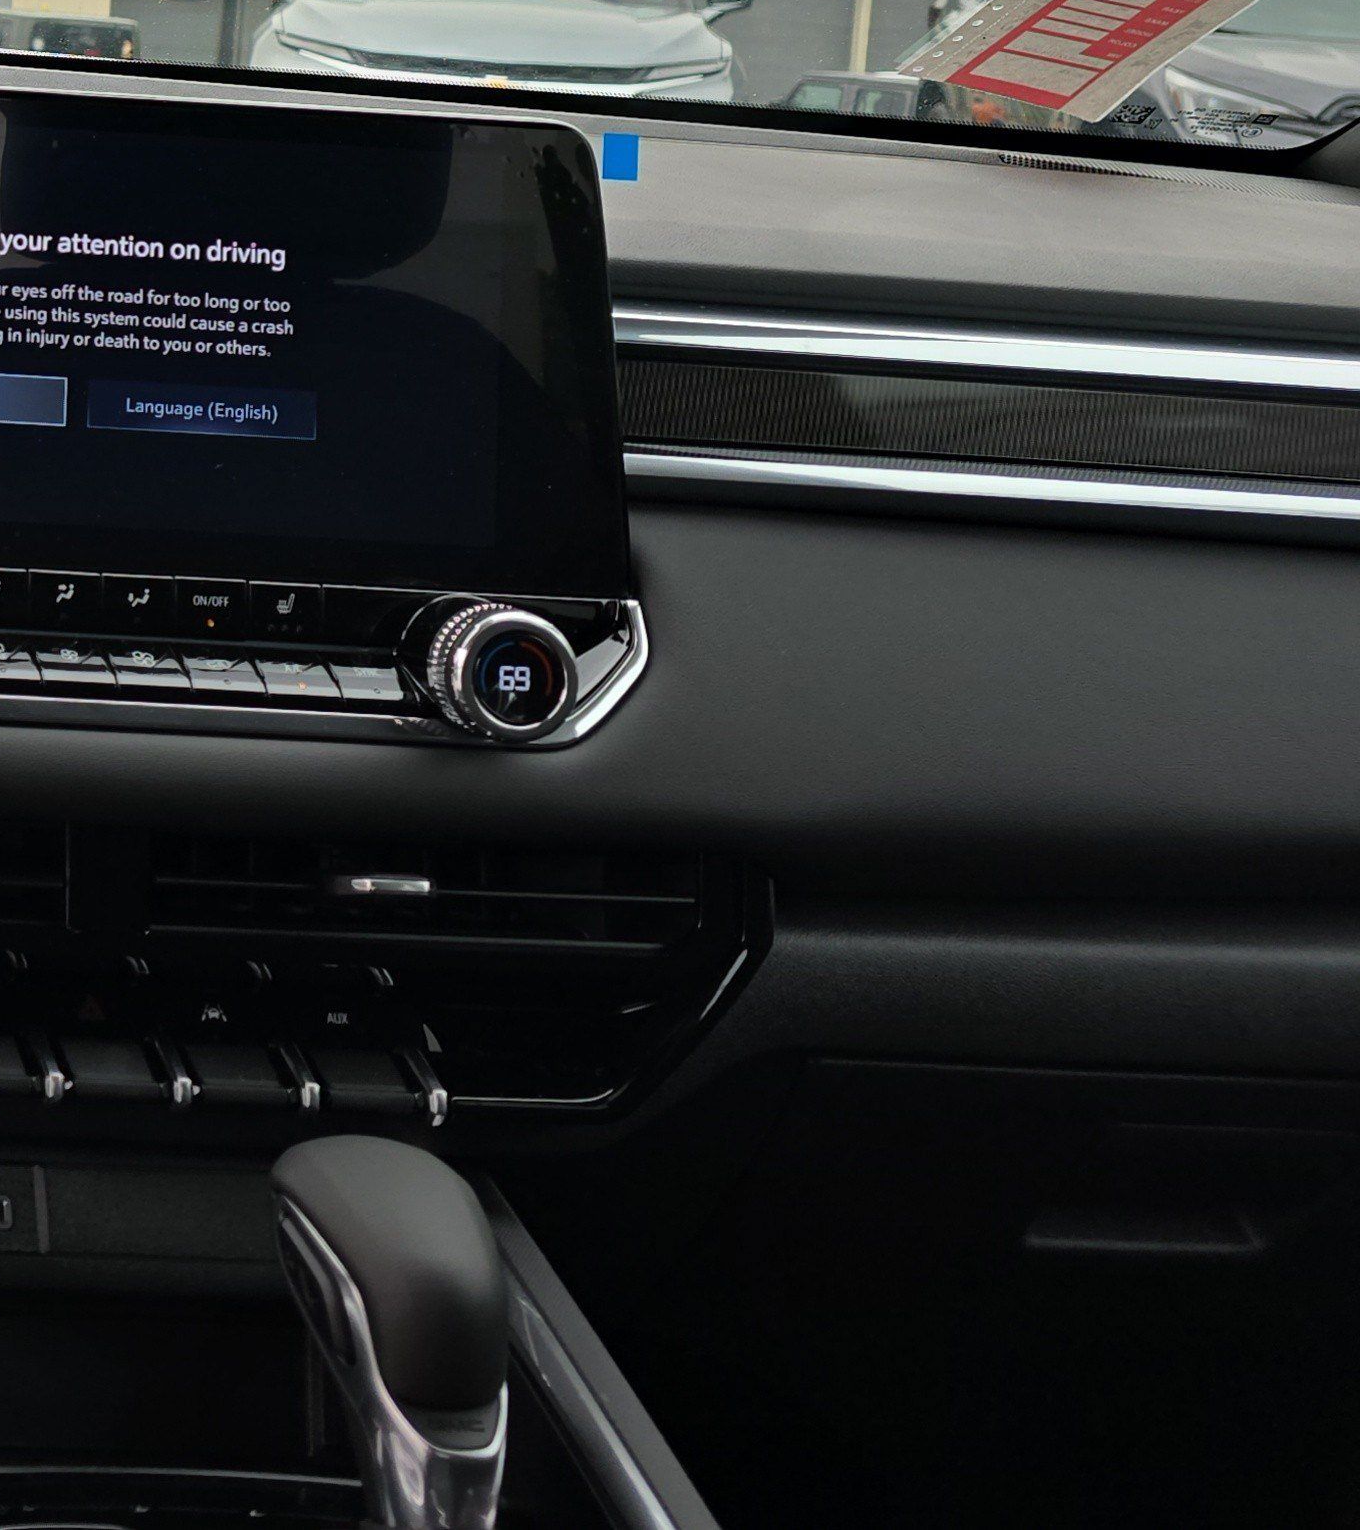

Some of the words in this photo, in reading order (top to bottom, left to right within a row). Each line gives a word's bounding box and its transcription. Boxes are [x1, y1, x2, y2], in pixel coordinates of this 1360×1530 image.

[0, 232, 52, 257] your
[56, 232, 165, 260] attention
[169, 242, 201, 262] on
[205, 239, 287, 272] driving
[11, 284, 48, 303] eyes
[50, 282, 76, 301] off
[77, 284, 104, 302] the
[107, 286, 144, 305] road
[146, 288, 171, 307] for
[173, 291, 201, 308] too
[204, 291, 240, 314] long
[242, 296, 261, 312] or
[263, 295, 291, 313] too
[4, 305, 48, 326] using
[50, 307, 81, 324] this
[83, 310, 140, 330] system
[143, 312, 187, 330] could
[189, 316, 236, 333] cause
[238, 320, 249, 334] a
[251, 318, 295, 336] crash
[7, 328, 23, 344] in
[25, 329, 71, 350] injury
[73, 332, 92, 347] or
[93, 330, 141, 349] death
[143, 334, 161, 350] to
[162, 337, 192, 357] you
[194, 339, 213, 354] or
[215, 338, 272, 357] others.
[125, 396, 204, 420] Language
[206, 400, 280, 424] (English)
[192, 594, 230, 609] ON/OFF
[498, 665, 531, 693] 69
